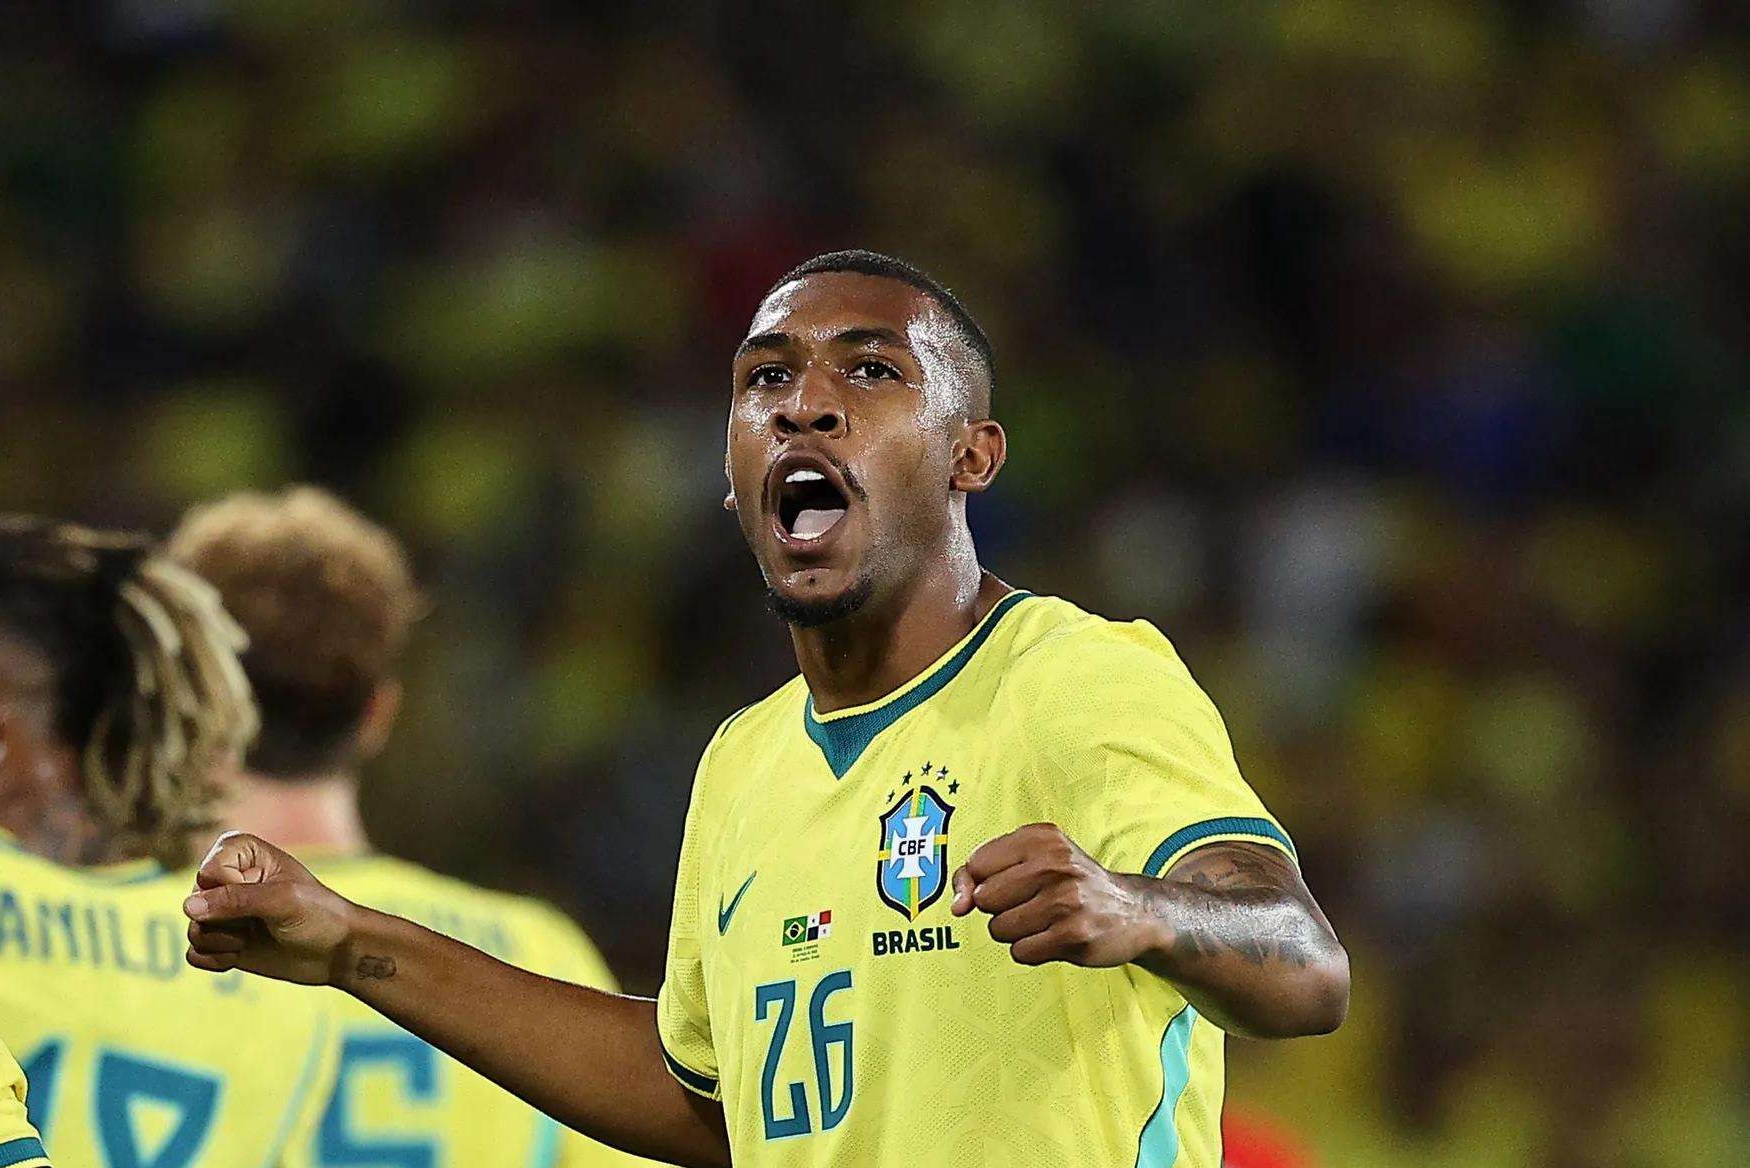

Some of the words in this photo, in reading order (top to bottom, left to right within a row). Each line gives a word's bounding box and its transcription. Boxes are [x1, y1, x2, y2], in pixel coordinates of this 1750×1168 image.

[898, 838, 927, 856] CBF
[872, 925, 961, 956] BRASIL
[754, 969, 854, 1141] 26
